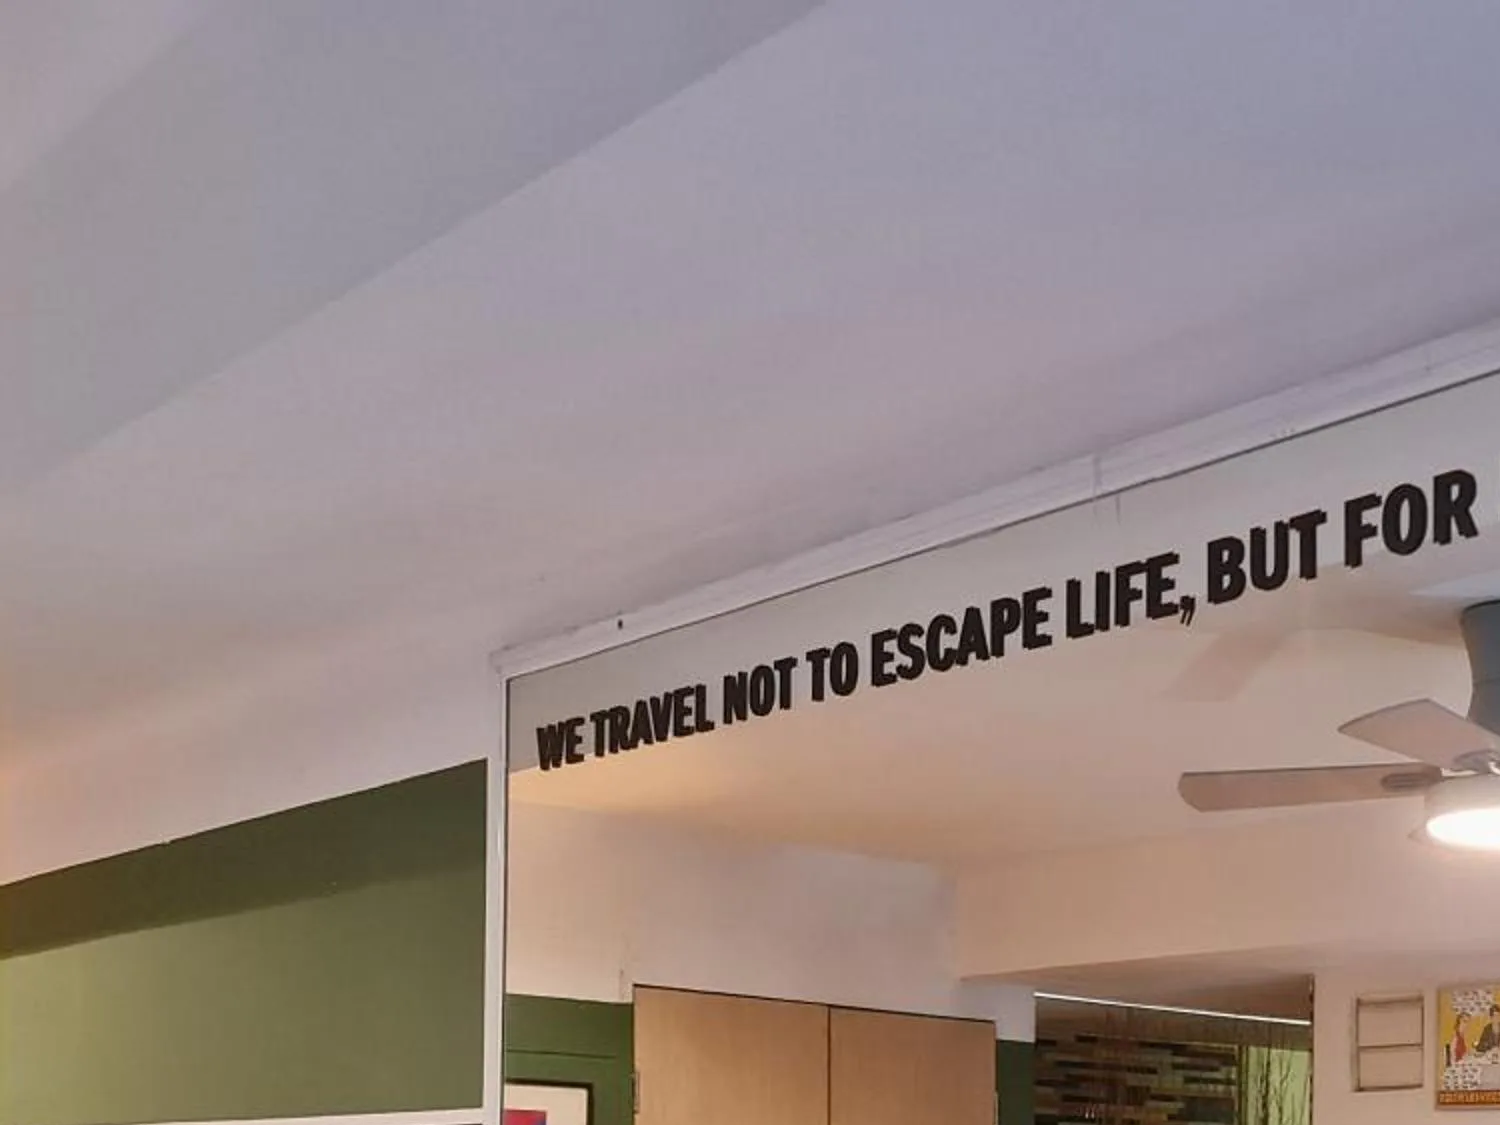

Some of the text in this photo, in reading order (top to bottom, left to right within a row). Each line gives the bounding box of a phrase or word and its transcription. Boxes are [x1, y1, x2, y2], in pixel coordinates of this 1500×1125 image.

[536, 717, 586, 771] WE
[590, 683, 715, 757] TRAVEL
[723, 656, 798, 725] NOT
[806, 641, 859, 702] TO
[871, 586, 1053, 688] ESCAPE
[1066, 551, 1197, 639] LIFE,
[1207, 509, 1327, 605] BUT
[1344, 469, 1479, 569] FOR
